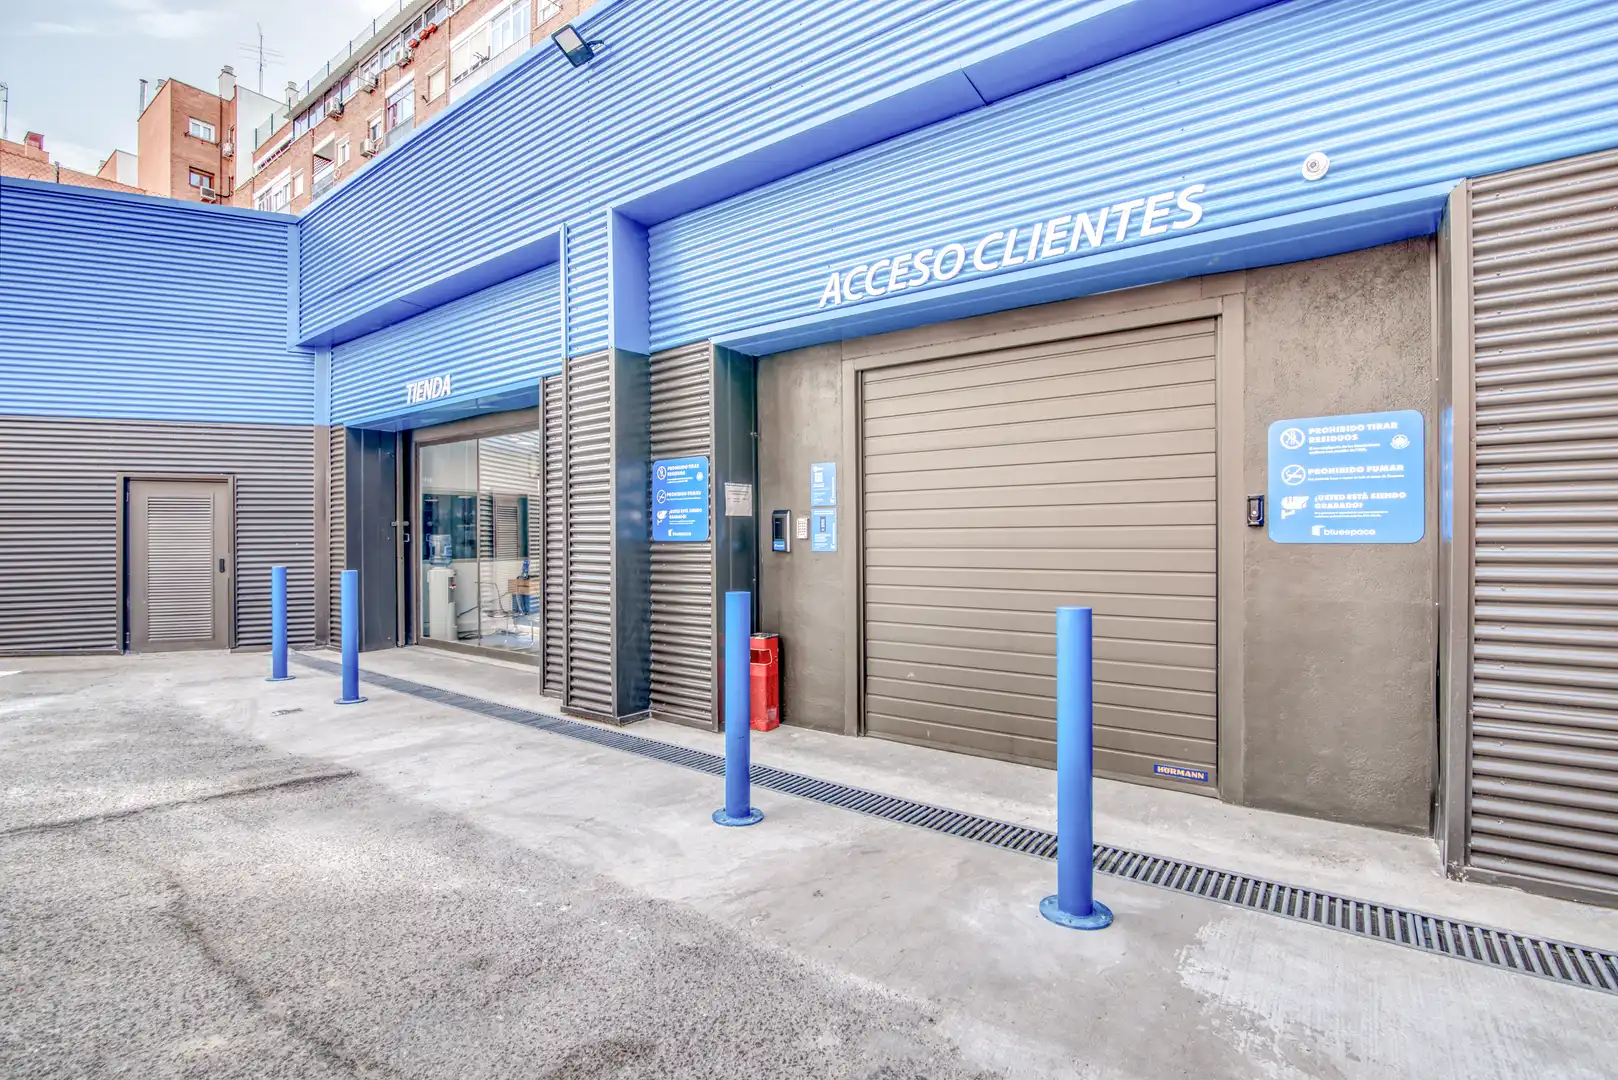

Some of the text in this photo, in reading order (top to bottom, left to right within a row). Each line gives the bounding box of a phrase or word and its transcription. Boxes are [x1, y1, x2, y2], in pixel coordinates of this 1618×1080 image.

[818, 184, 1206, 308] ACCESO CLIENTES
[406, 374, 451, 404] TIENDA
[1308, 421, 1398, 435] PROHIBIDO TIRAR
[1308, 434, 1359, 443] RESIDUOS
[1307, 464, 1405, 475] PROHIBIDO FUMAR
[1323, 528, 1376, 536] bluespace
